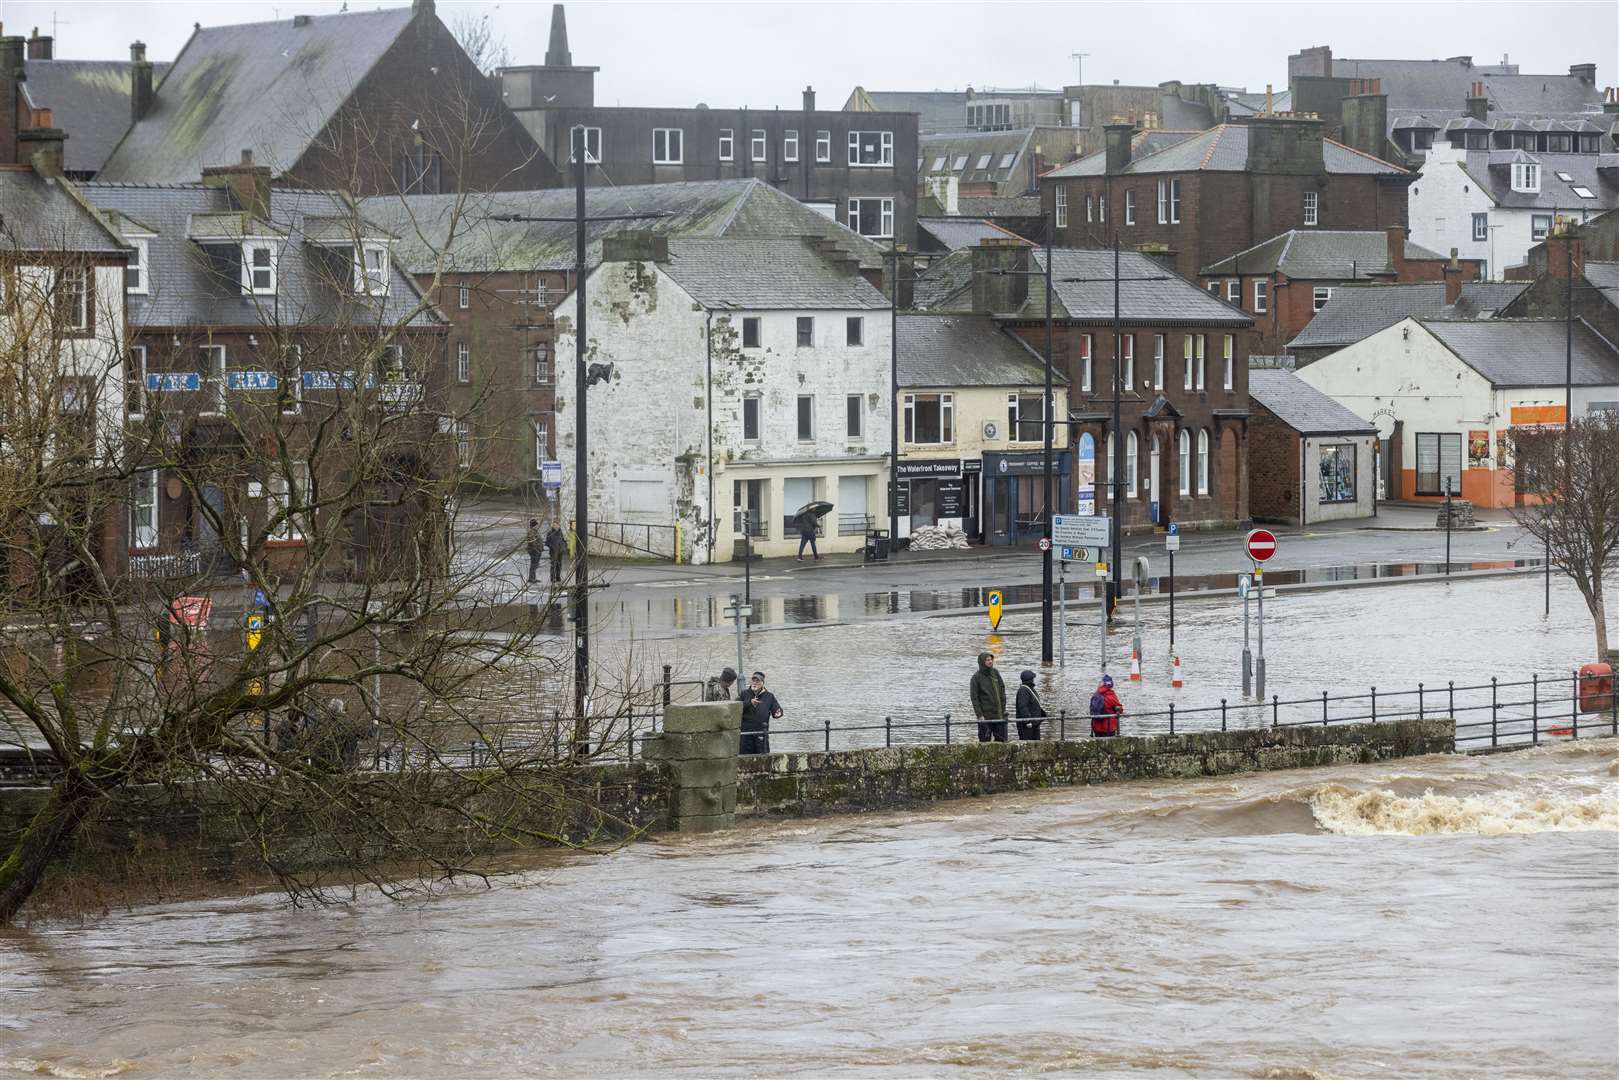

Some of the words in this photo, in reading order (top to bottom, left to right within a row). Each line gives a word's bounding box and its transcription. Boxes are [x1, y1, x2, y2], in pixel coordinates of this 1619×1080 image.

[933, 464, 958, 472] Takeaway
[1170, 524, 1176, 533] P
[1041, 541, 1050, 549] 20
[1063, 548, 1070, 558] P
